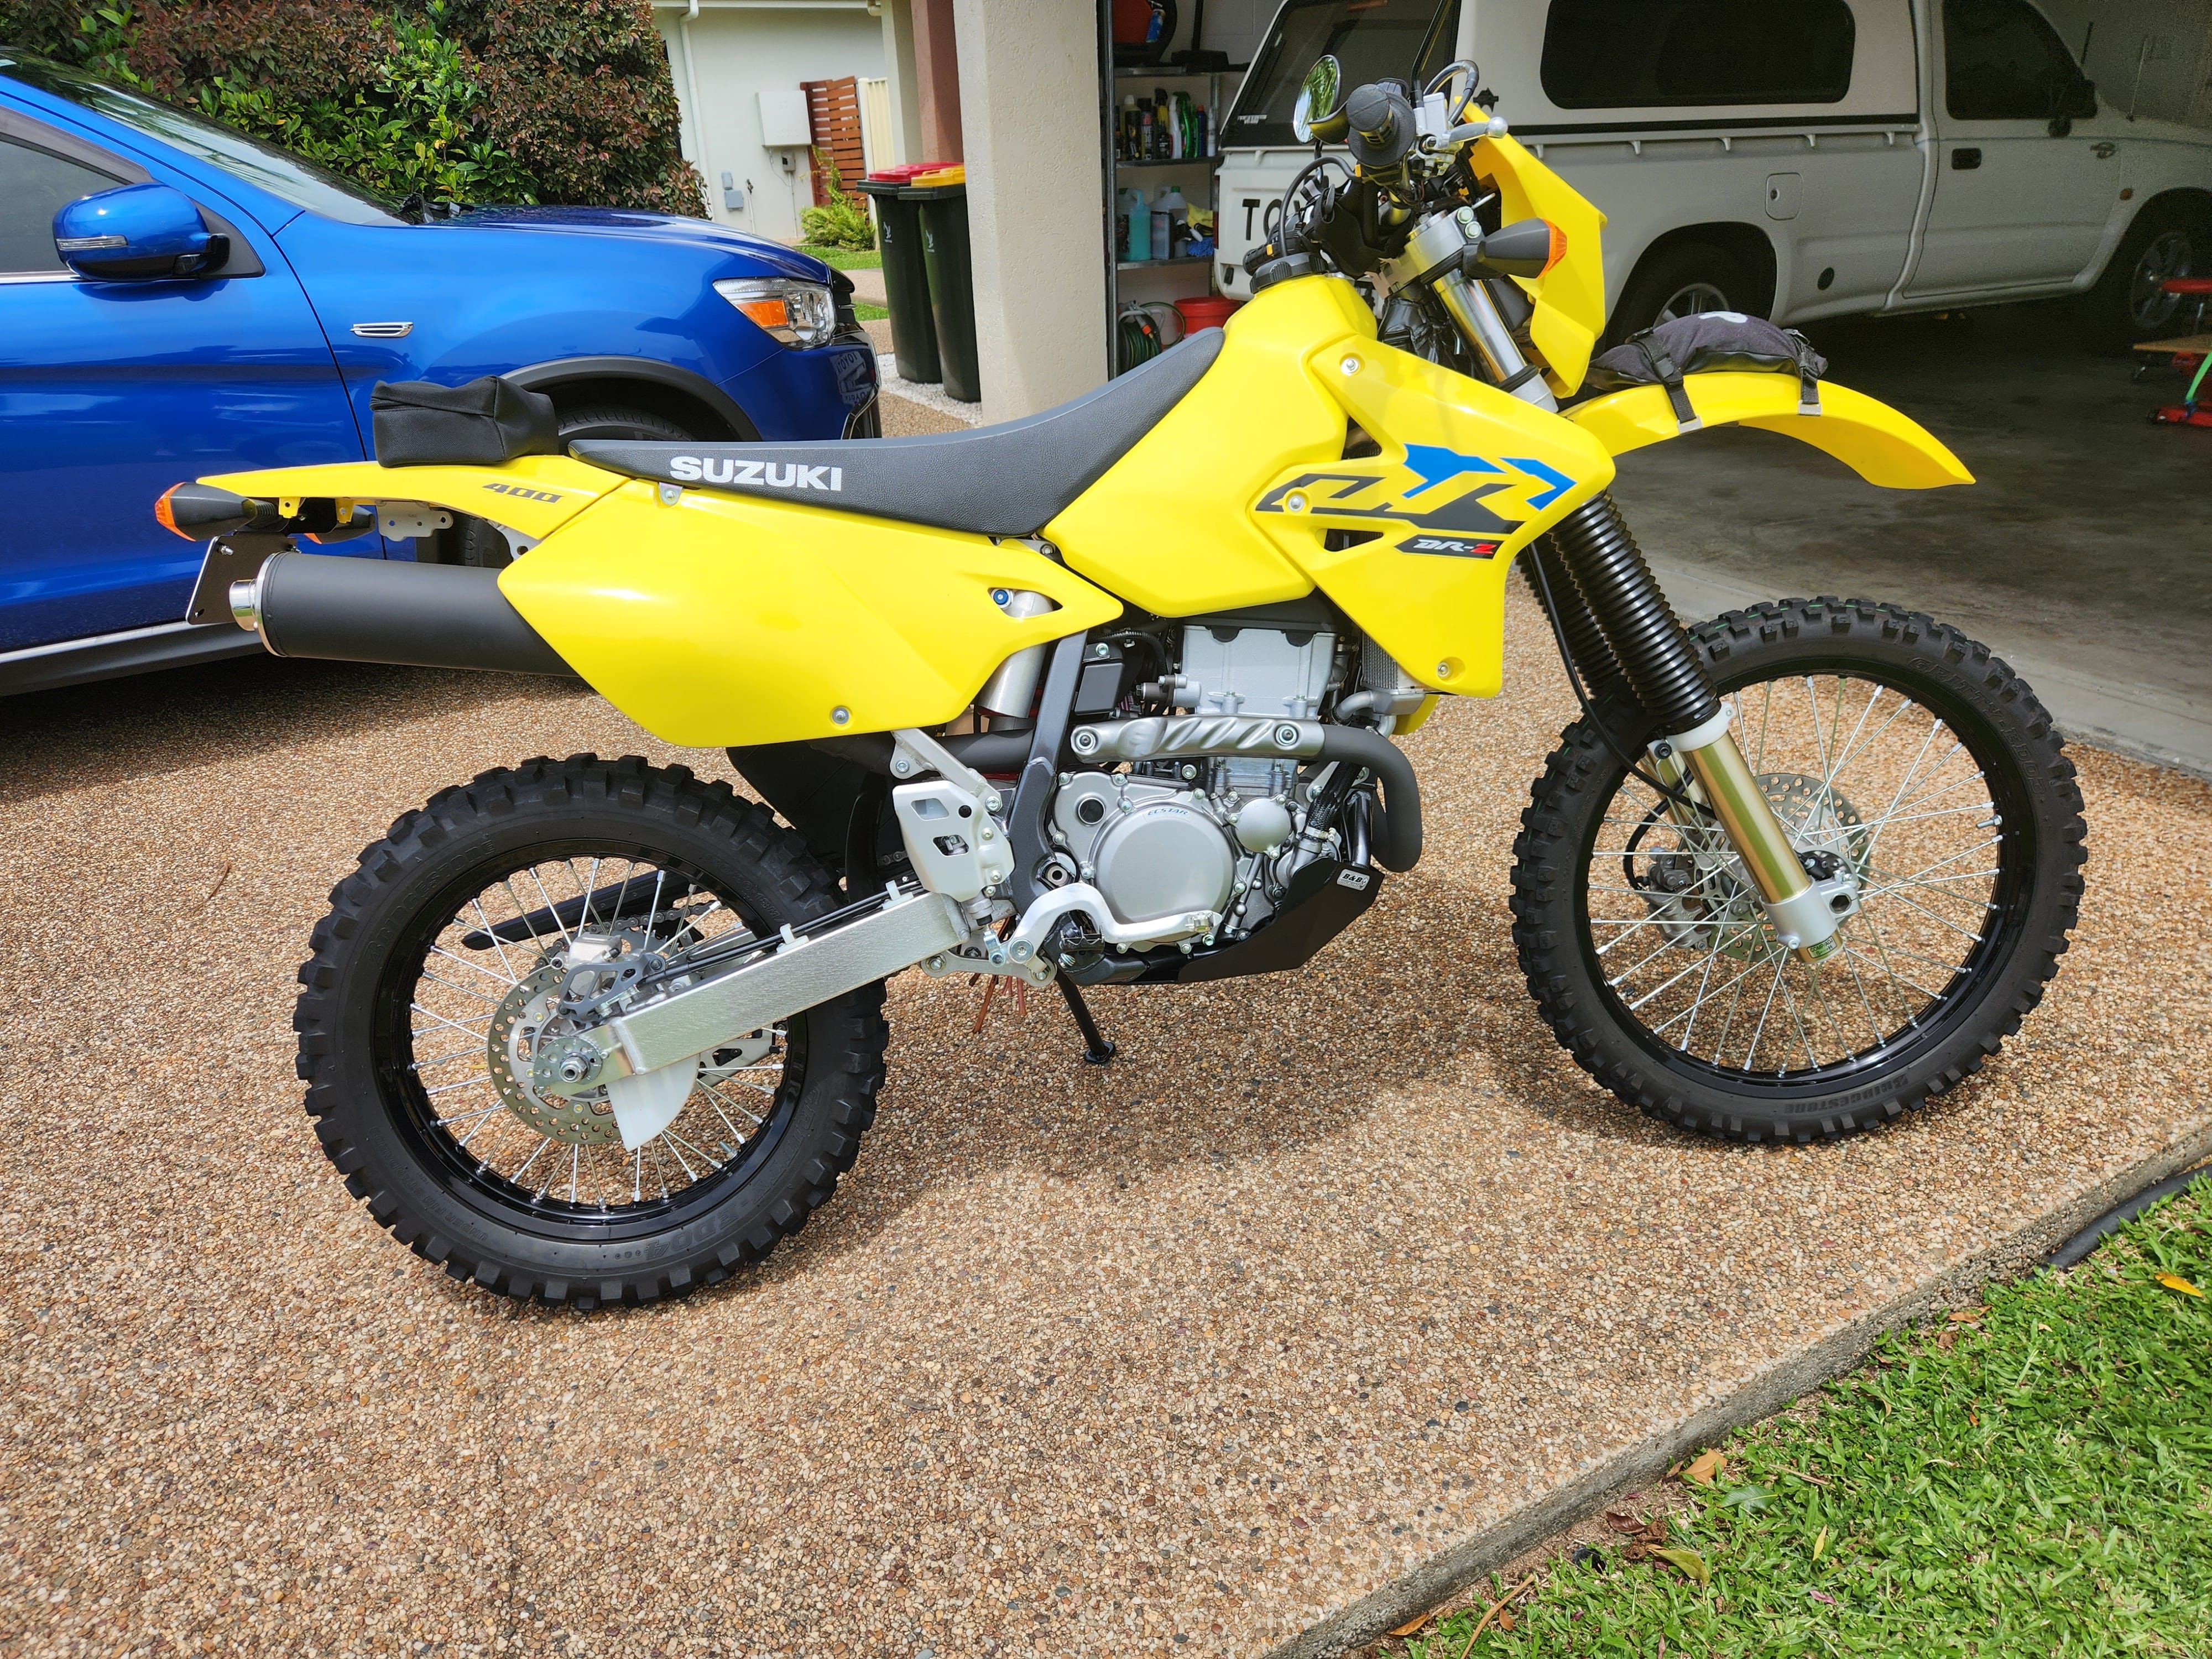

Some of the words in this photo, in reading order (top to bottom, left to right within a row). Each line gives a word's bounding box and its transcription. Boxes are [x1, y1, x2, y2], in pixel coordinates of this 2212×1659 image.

[670, 456, 836, 491] SUZUKI
[482, 483, 564, 503] 400
[1413, 539, 1497, 554] DR-Z
[1342, 874, 1363, 883] B&B
[1785, 1074, 1908, 1114] BRIDGESTONE
